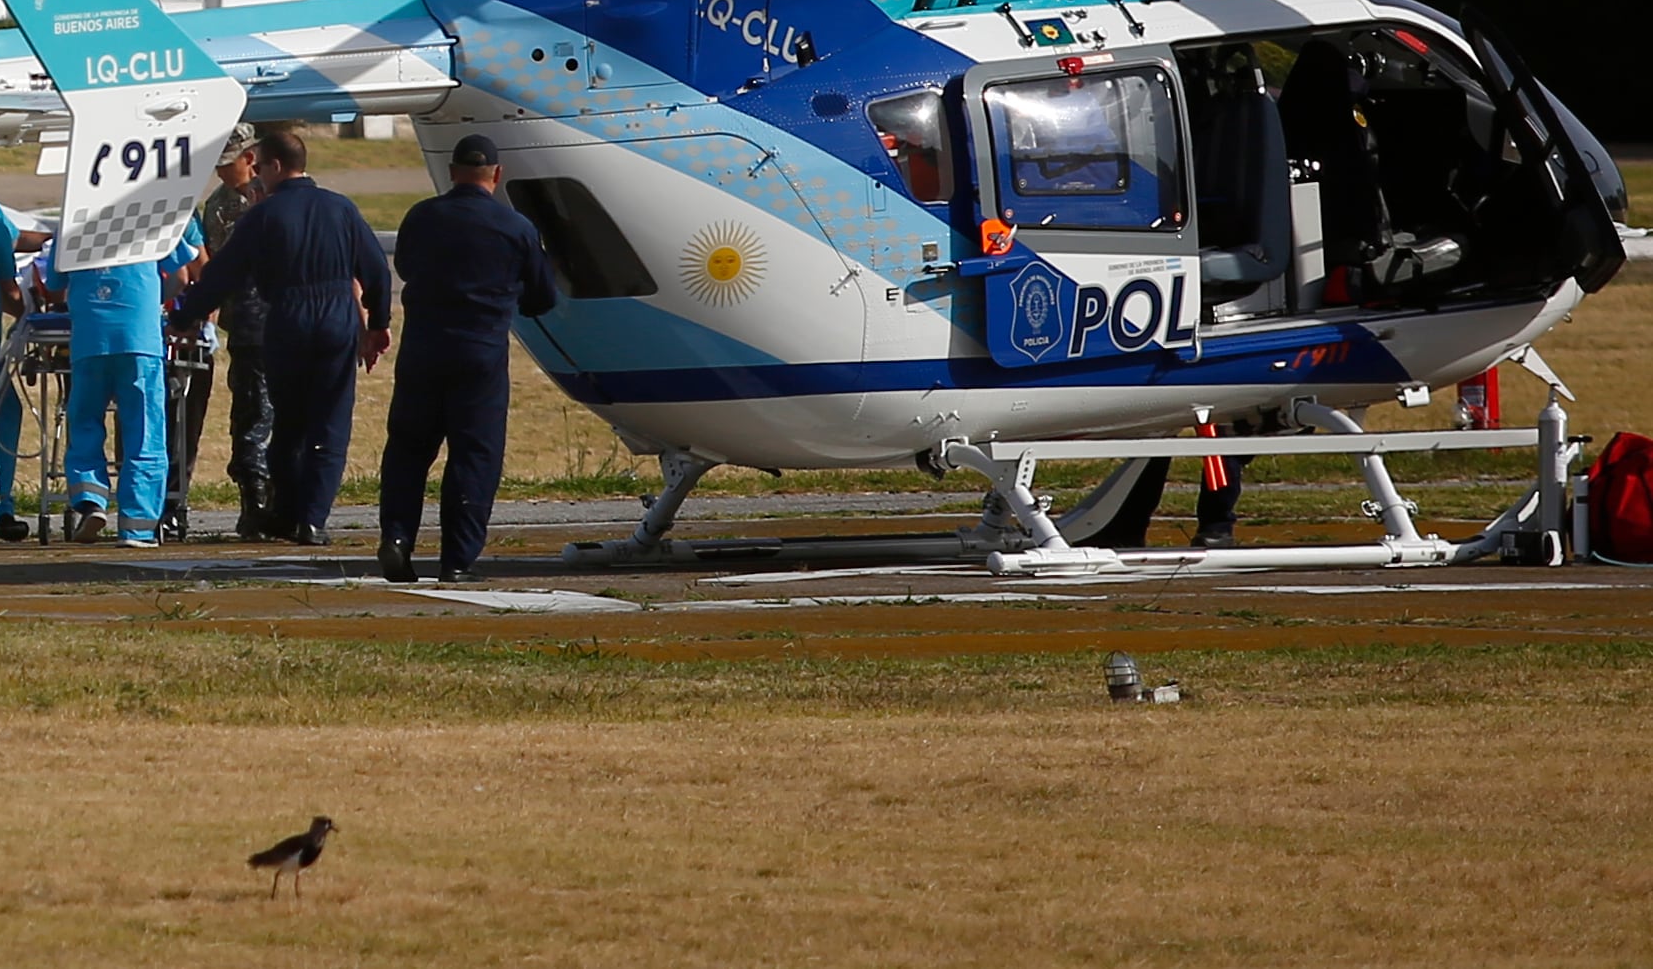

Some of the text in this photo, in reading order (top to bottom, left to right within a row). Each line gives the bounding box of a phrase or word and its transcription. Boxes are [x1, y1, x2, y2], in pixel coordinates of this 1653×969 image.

[54, 16, 140, 35] BUENOS AIRES
[86, 48, 184, 84] LQ-CLU
[122, 135, 191, 182] 911
[1067, 272, 1195, 359] POL
